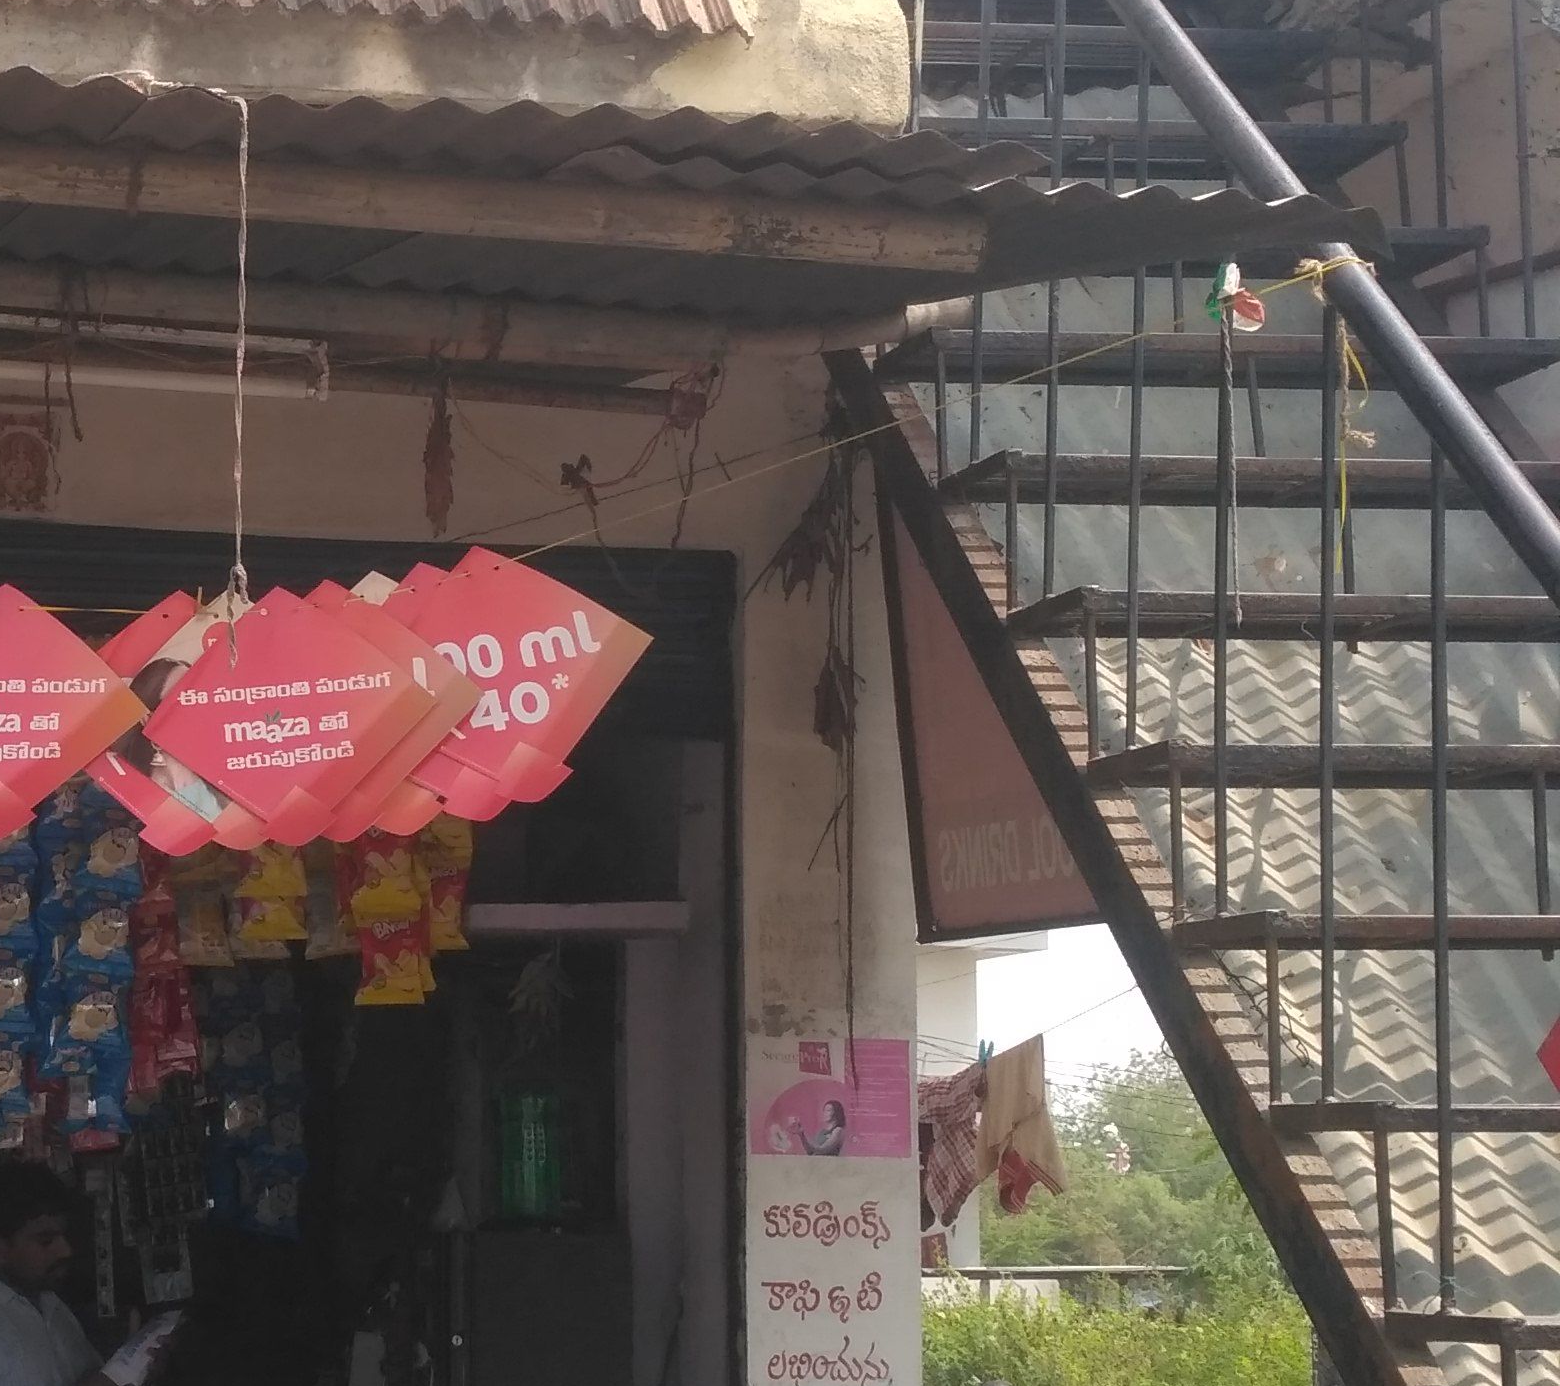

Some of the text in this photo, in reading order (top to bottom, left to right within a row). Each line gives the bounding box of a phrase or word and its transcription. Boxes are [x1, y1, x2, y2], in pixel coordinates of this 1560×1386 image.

[519, 611, 602, 667] ml
[32, 678, 107, 694] పండుగ
[177, 688, 208, 706] ఈ
[212, 679, 311, 704] సంక్రాంతి
[316, 671, 391, 695] పండుగ
[29, 713, 59, 731] తో
[223, 711, 349, 744] maaza తో
[226, 740, 355, 771] జరుపుకోండి
